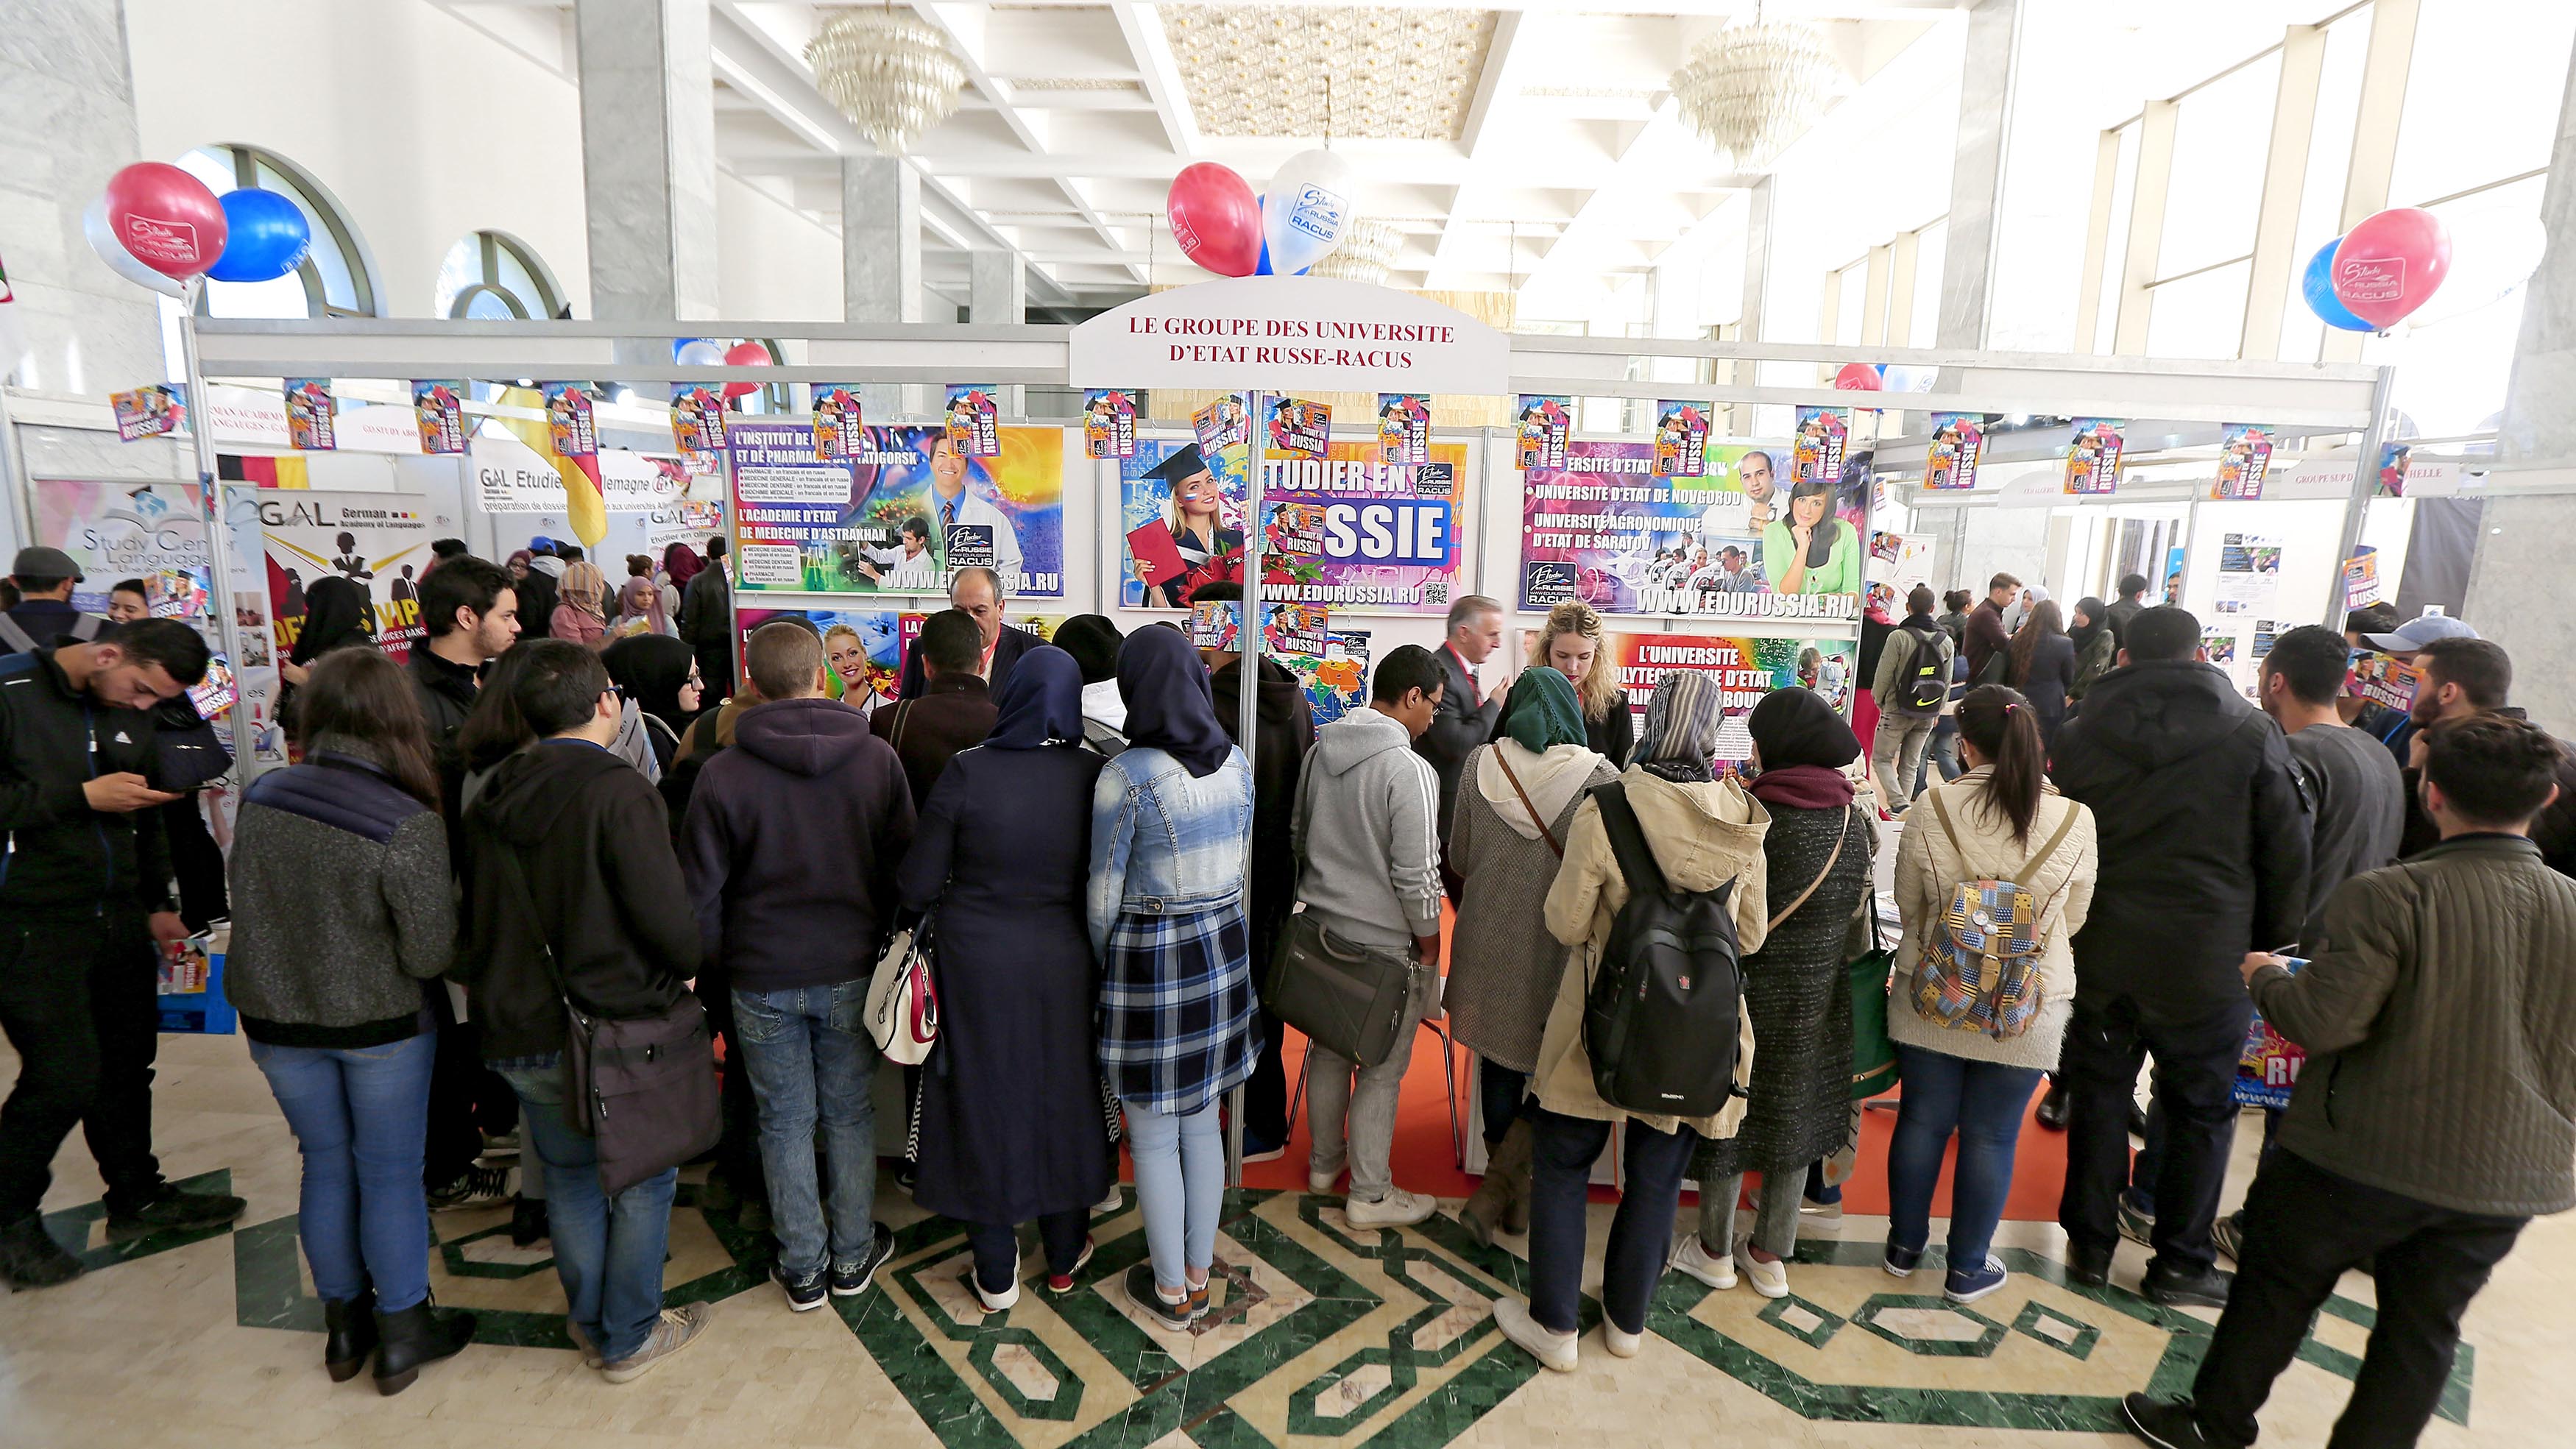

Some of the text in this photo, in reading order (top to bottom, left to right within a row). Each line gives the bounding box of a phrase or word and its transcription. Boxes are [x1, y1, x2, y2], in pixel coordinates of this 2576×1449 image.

[1301, 189, 1334, 208] Study
[1292, 216, 1334, 239] RACUS
[1310, 211, 1339, 227] RUSSIA
[1130, 317, 1454, 344] LE GROUPE DES UNIVERSITE
[1170, 344, 1412, 369] D'ETAT RUSSE-RACUS
[576, 410, 594, 452] RUSSIE
[704, 410, 726, 447] RUSSIE
[735, 431, 793, 445] L'INSTITUT
[795, 433, 810, 445] DE
[846, 412, 860, 454] RUSSIE
[980, 413, 997, 453] RUSSIE
[1119, 414, 1133, 456] RUSSIE
[1302, 426, 1318, 436] STUDY
[1204, 429, 1239, 456] RUSSIE
[1290, 433, 1325, 453] RUSSIA
[1412, 419, 1426, 463] RUSSIE
[1549, 424, 1565, 467] RUSSIE
[736, 450, 750, 462] ET
[751, 450, 765, 463] DE
[1686, 431, 1704, 473] RUSSIE
[1826, 435, 1844, 479] RUSSIE
[1567, 456, 1652, 475] ERSITE D'ETAT
[1958, 442, 1977, 485] RUSSIE
[2098, 447, 2118, 490] RUSSIE
[481, 469, 648, 495] GAL Etudie lemagne
[1264, 461, 1406, 492] TUDIER EN
[2245, 453, 2268, 497] RUSSIE
[1535, 484, 1741, 506] UNIVERSITE D'ETAT DE NOVGOROD
[261, 500, 335, 526] GAL
[342, 508, 386, 518] German
[484, 500, 530, 513] préparation
[531, 502, 540, 510] de
[542, 502, 566, 510] dossie
[739, 509, 838, 523] L'ACADEMIE D'ETAT
[341, 520, 374, 528] Academy
[385, 521, 425, 529] Languages
[651, 511, 685, 525] GAL
[1534, 513, 1701, 533] UNIVERSITE AGRONOMIQUE
[84, 529, 147, 553] Study
[651, 534, 678, 544] Etudier
[740, 526, 887, 542] DE MEDECINE D'ASTRAKHAN
[1298, 530, 1314, 539] STUDY
[1325, 504, 1444, 559] SSIE
[1533, 534, 1651, 550] D'ETAT DE SARATOV
[1287, 536, 1322, 555] RUSSIA
[885, 570, 1058, 592] WWW.EDSSIA.RU
[1529, 595, 1574, 605] RACUS
[1637, 589, 1854, 617] WWW.EDURUSSIA.RU
[2349, 587, 2380, 608] RUSS
[374, 598, 420, 628] VIP
[406, 626, 427, 638] DANS
[905, 621, 918, 634] LA
[1298, 629, 1313, 639] STUDY
[1193, 634, 1217, 647] RUSSIE
[1285, 637, 1323, 654] RUSSIA
[1639, 645, 1738, 665] L'UNIVERSITE
[1725, 669, 1774, 688] D'ETAT
[1919, 666, 1935, 676] NIKE
[197, 690, 233, 715] RUSSIE
[2362, 683, 2408, 712] RUSSIA
